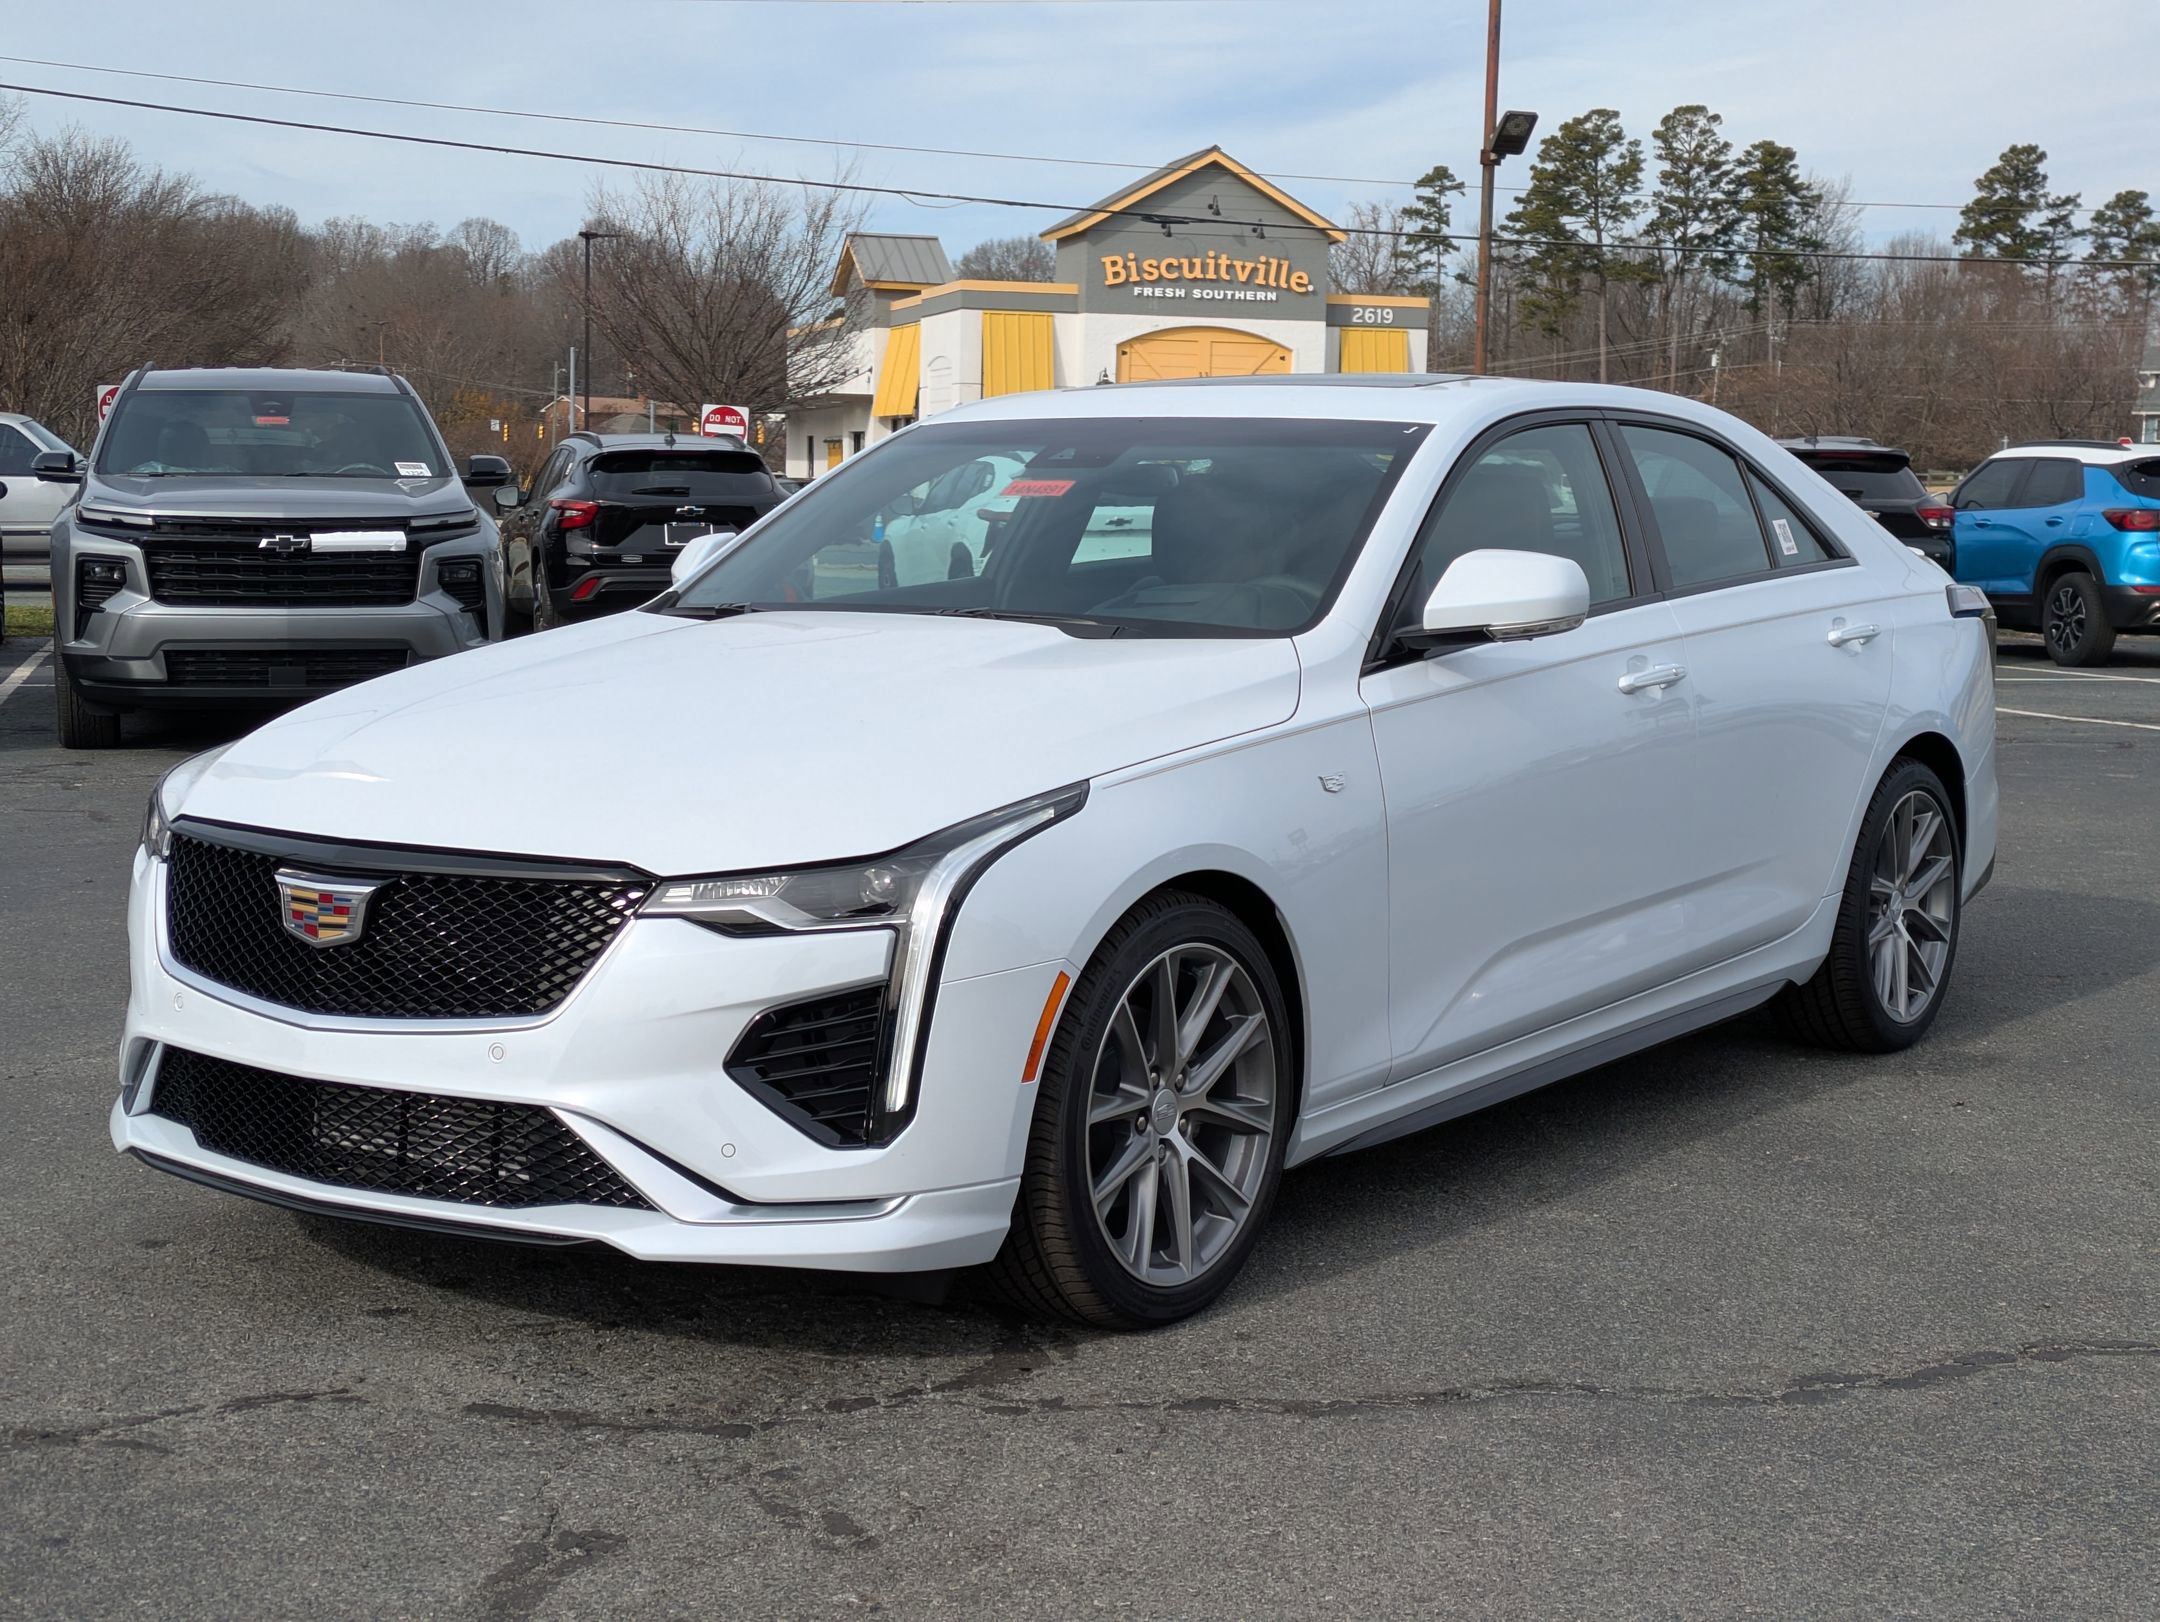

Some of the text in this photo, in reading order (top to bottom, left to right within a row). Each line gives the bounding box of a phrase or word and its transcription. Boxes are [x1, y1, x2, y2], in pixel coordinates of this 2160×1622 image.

[1101, 250, 1309, 293] Biscuitville
[1134, 286, 1277, 301] FRESH SOUTHERN
[1352, 307, 1394, 324] 2619
[709, 414, 742, 424] DO NOT
